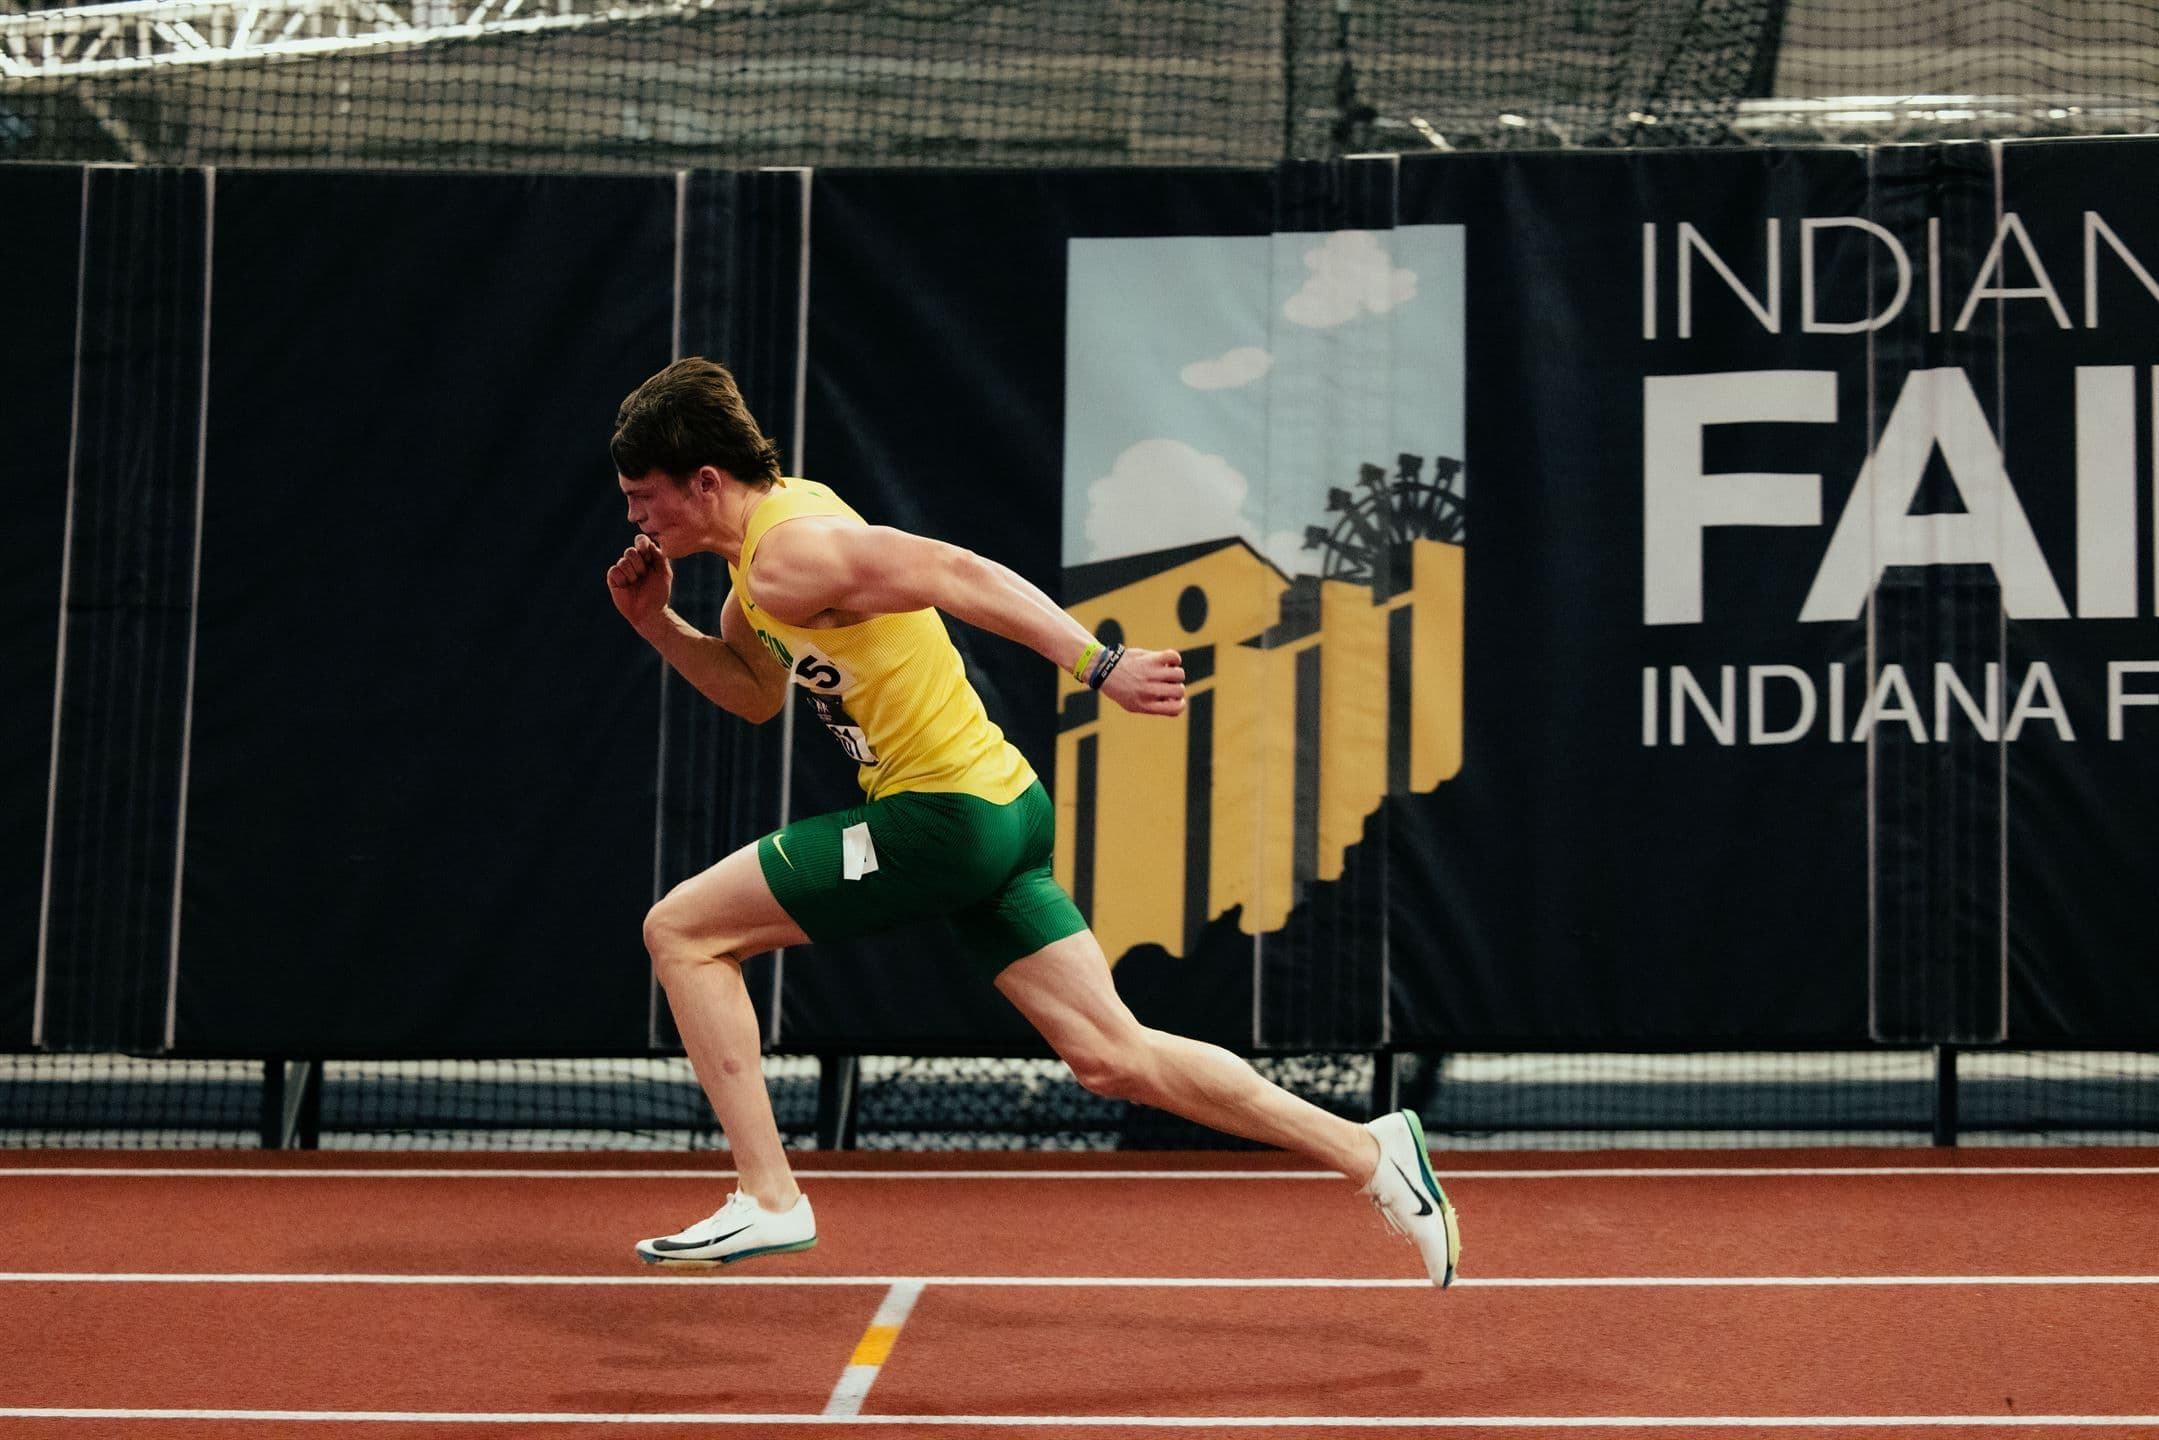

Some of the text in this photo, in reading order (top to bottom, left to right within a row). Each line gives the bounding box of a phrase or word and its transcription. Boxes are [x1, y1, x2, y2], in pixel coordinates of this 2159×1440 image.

[1643, 364, 2159, 625] FAI
[795, 655, 841, 689] 5
[1642, 661, 2077, 746] INDIANA
